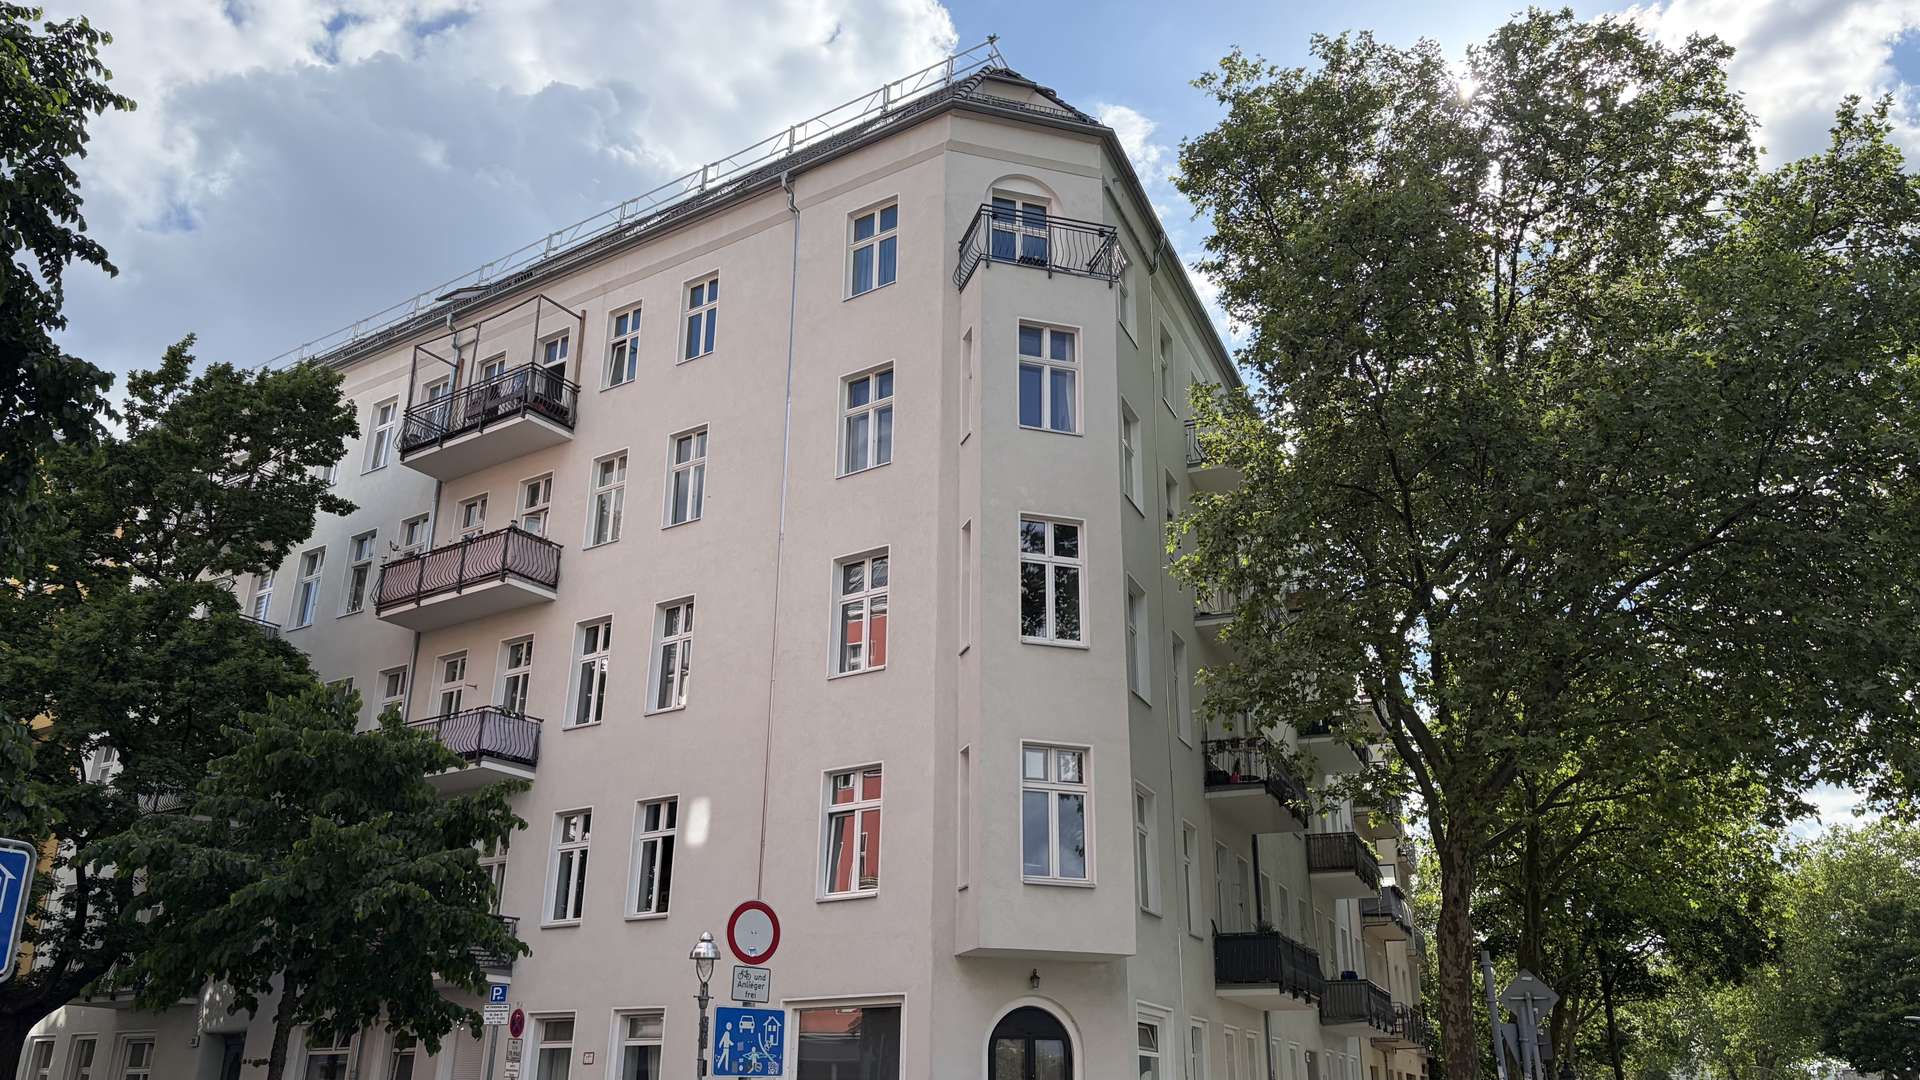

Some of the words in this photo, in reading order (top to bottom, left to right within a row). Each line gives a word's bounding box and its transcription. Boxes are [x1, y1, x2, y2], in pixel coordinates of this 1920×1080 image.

[754, 974, 767, 982] und
[737, 981, 765, 990] Anlieger
[492, 987, 502, 1000] P
[745, 991, 757, 999] frei
